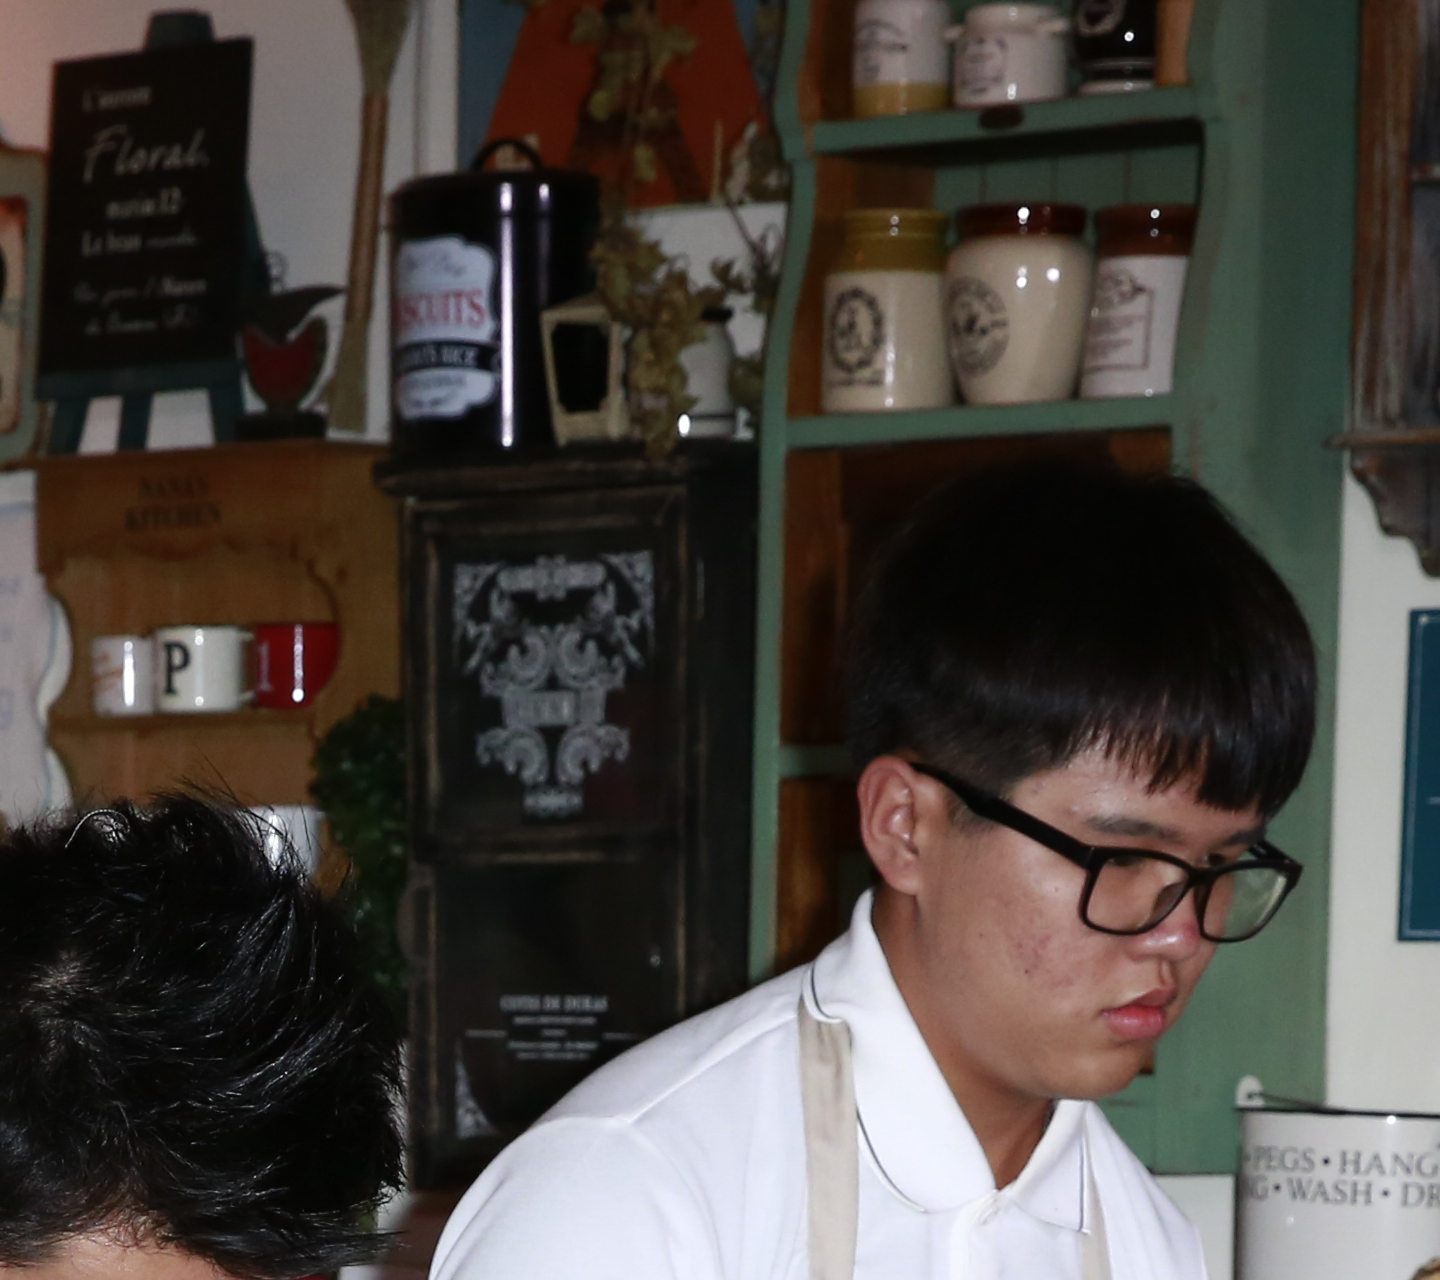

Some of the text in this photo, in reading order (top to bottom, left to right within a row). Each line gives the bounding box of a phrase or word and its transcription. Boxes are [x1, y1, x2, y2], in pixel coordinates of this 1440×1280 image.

[125, 502, 220, 532] KITCHEN
[165, 642, 191, 693] P
[1338, 1148, 1440, 1179] HANG
[1286, 1176, 1373, 1206] WASH
